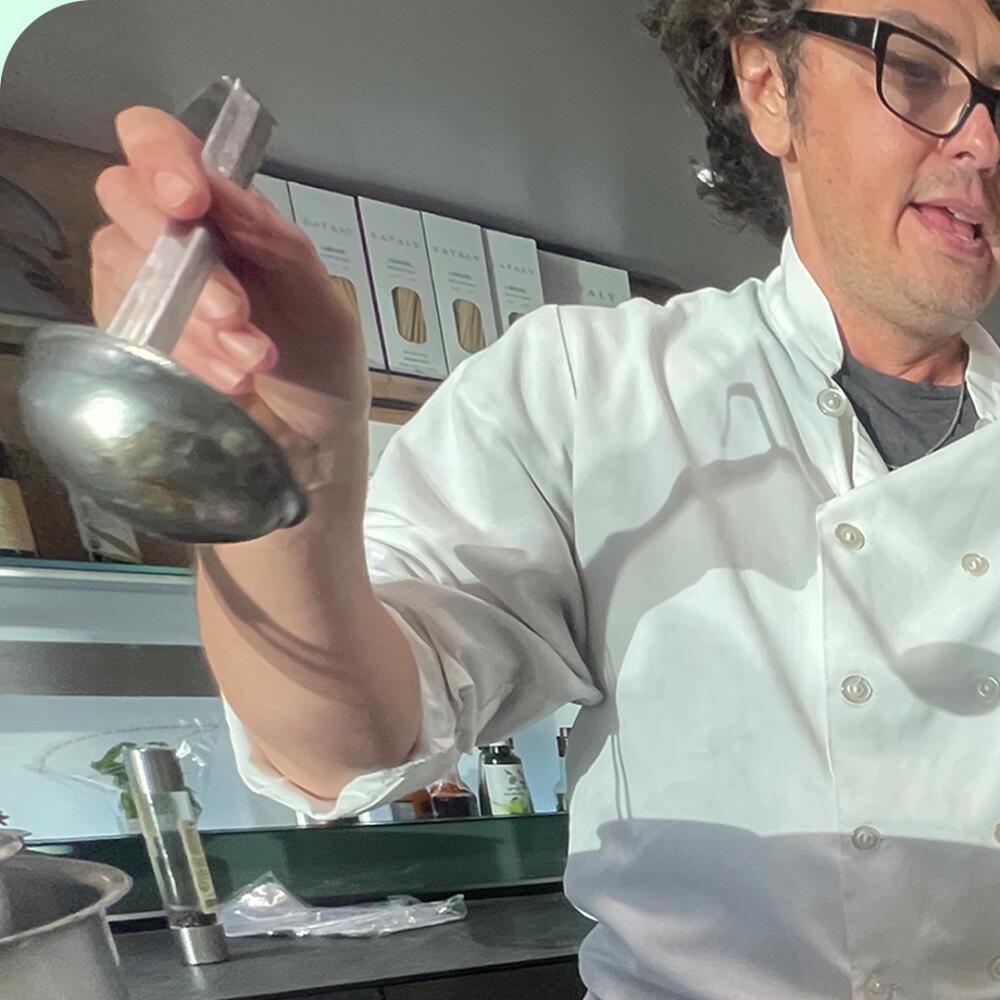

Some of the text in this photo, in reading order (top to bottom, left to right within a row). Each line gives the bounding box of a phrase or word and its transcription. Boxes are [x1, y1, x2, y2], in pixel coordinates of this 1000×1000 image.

[371, 231, 419, 248] EATALY
[433, 245, 479, 262] EATALY
[499, 263, 534, 276] ATALY
